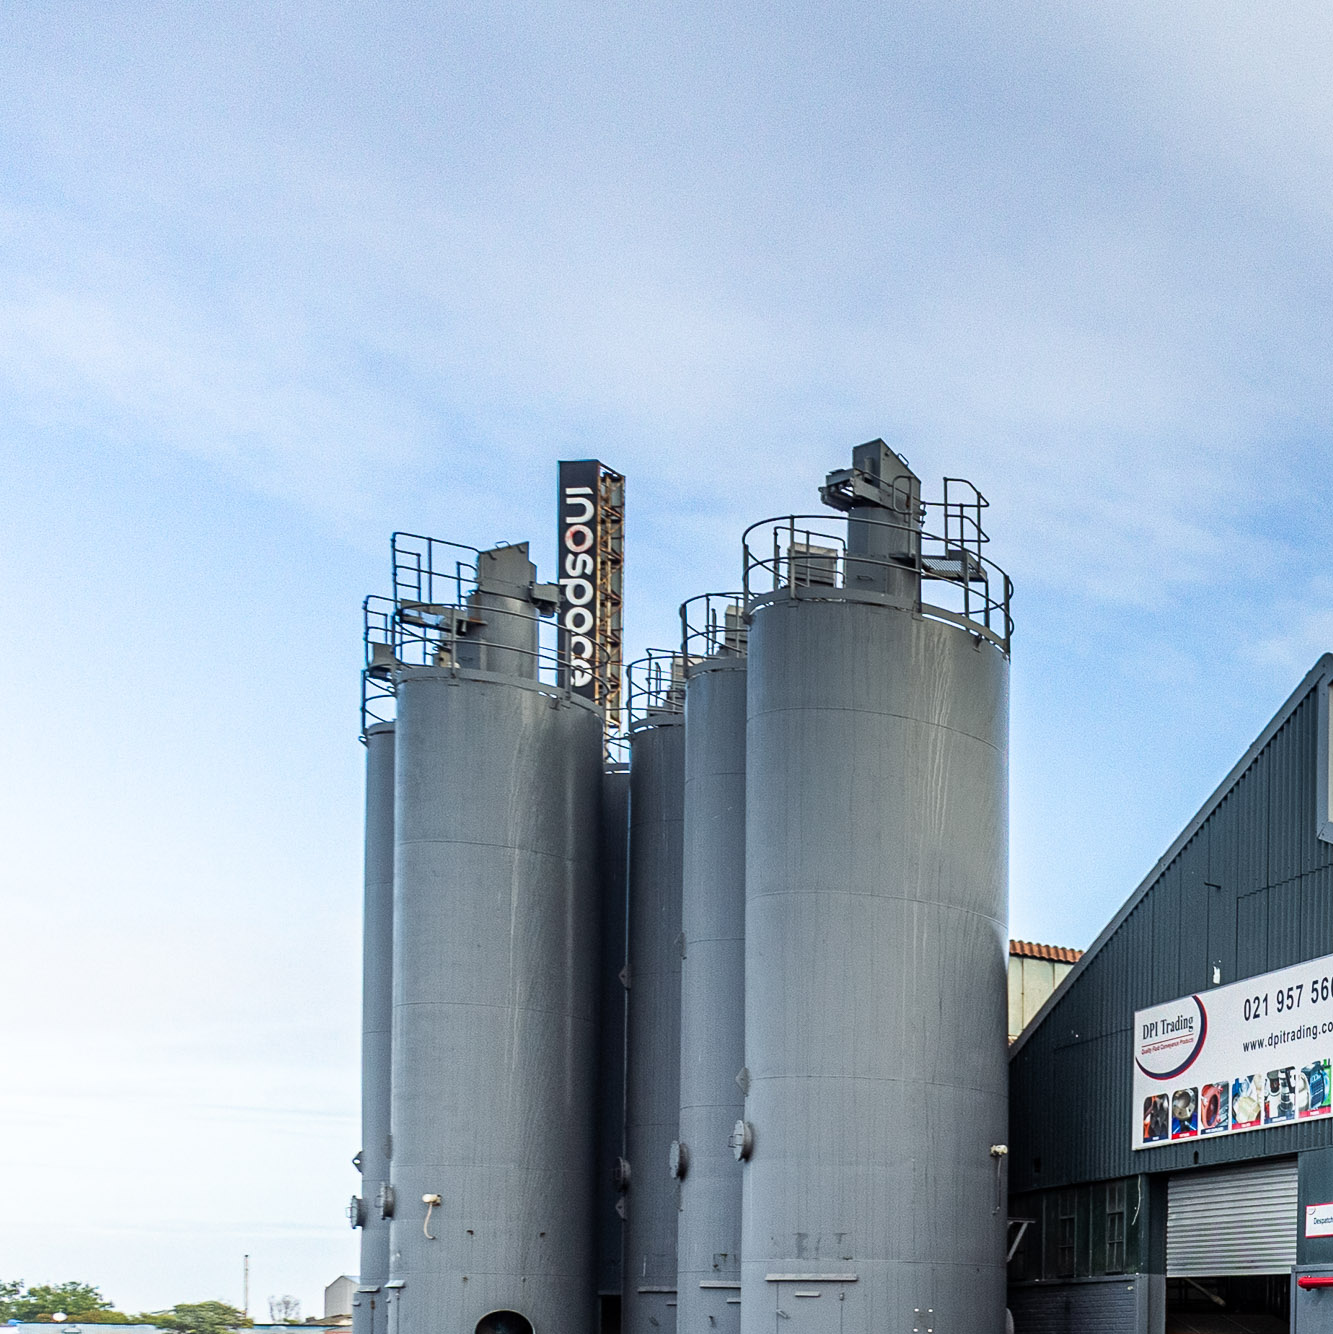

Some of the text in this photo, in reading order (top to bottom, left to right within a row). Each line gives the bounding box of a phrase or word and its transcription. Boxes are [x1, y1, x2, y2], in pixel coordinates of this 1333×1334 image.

[1243, 992, 1269, 1022] 021
[1276, 983, 1304, 1013] 957
[1142, 1014, 1194, 1040] DPI Trading
